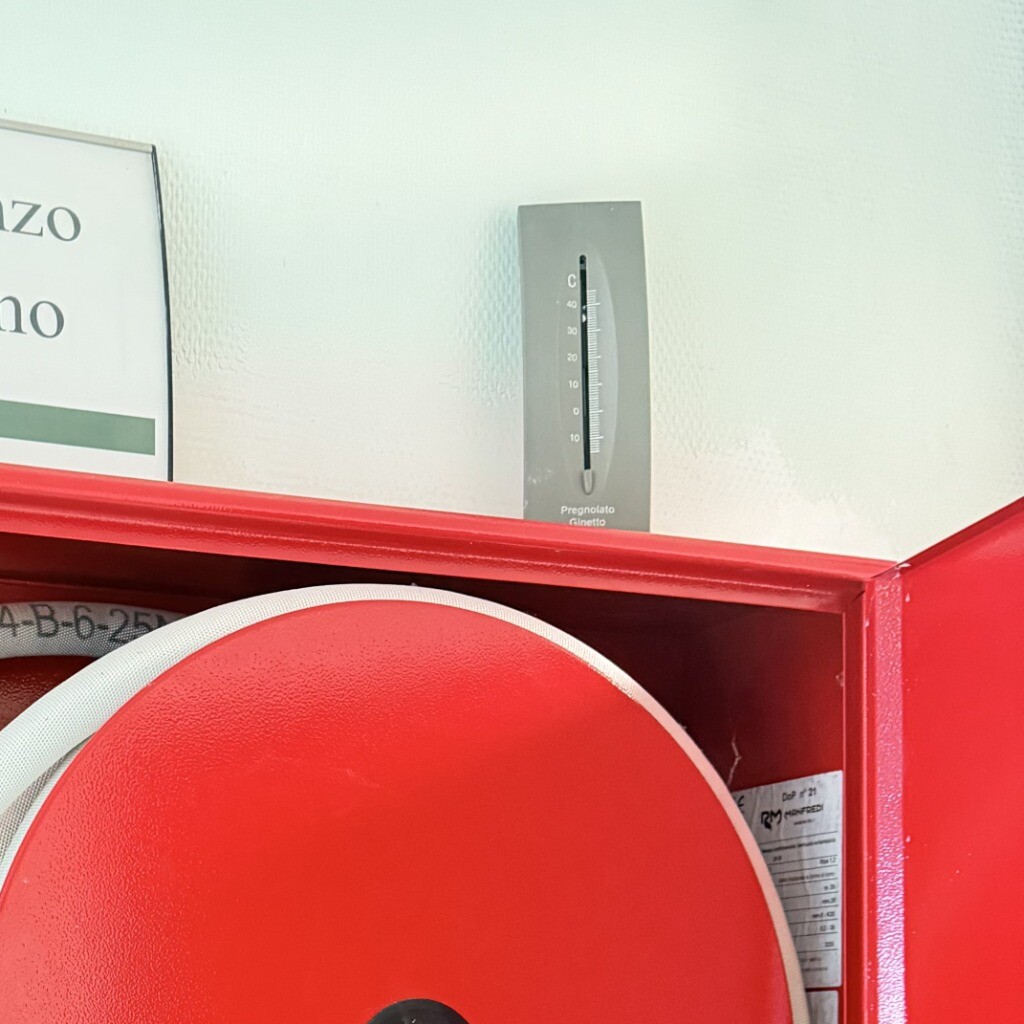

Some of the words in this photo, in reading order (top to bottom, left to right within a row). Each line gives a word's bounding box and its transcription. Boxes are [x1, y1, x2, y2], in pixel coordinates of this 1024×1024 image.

[568, 274, 576, 288] C
[566, 300, 577, 309] 40
[567, 326, 578, 336] 30
[567, 353, 578, 362] 20
[568, 379, 579, 389] 10
[573, 407, 580, 416] 0
[570, 433, 580, 443] 10
[560, 505, 616, 517] Pregnolato
[568, 518, 607, 528] Ginetto
